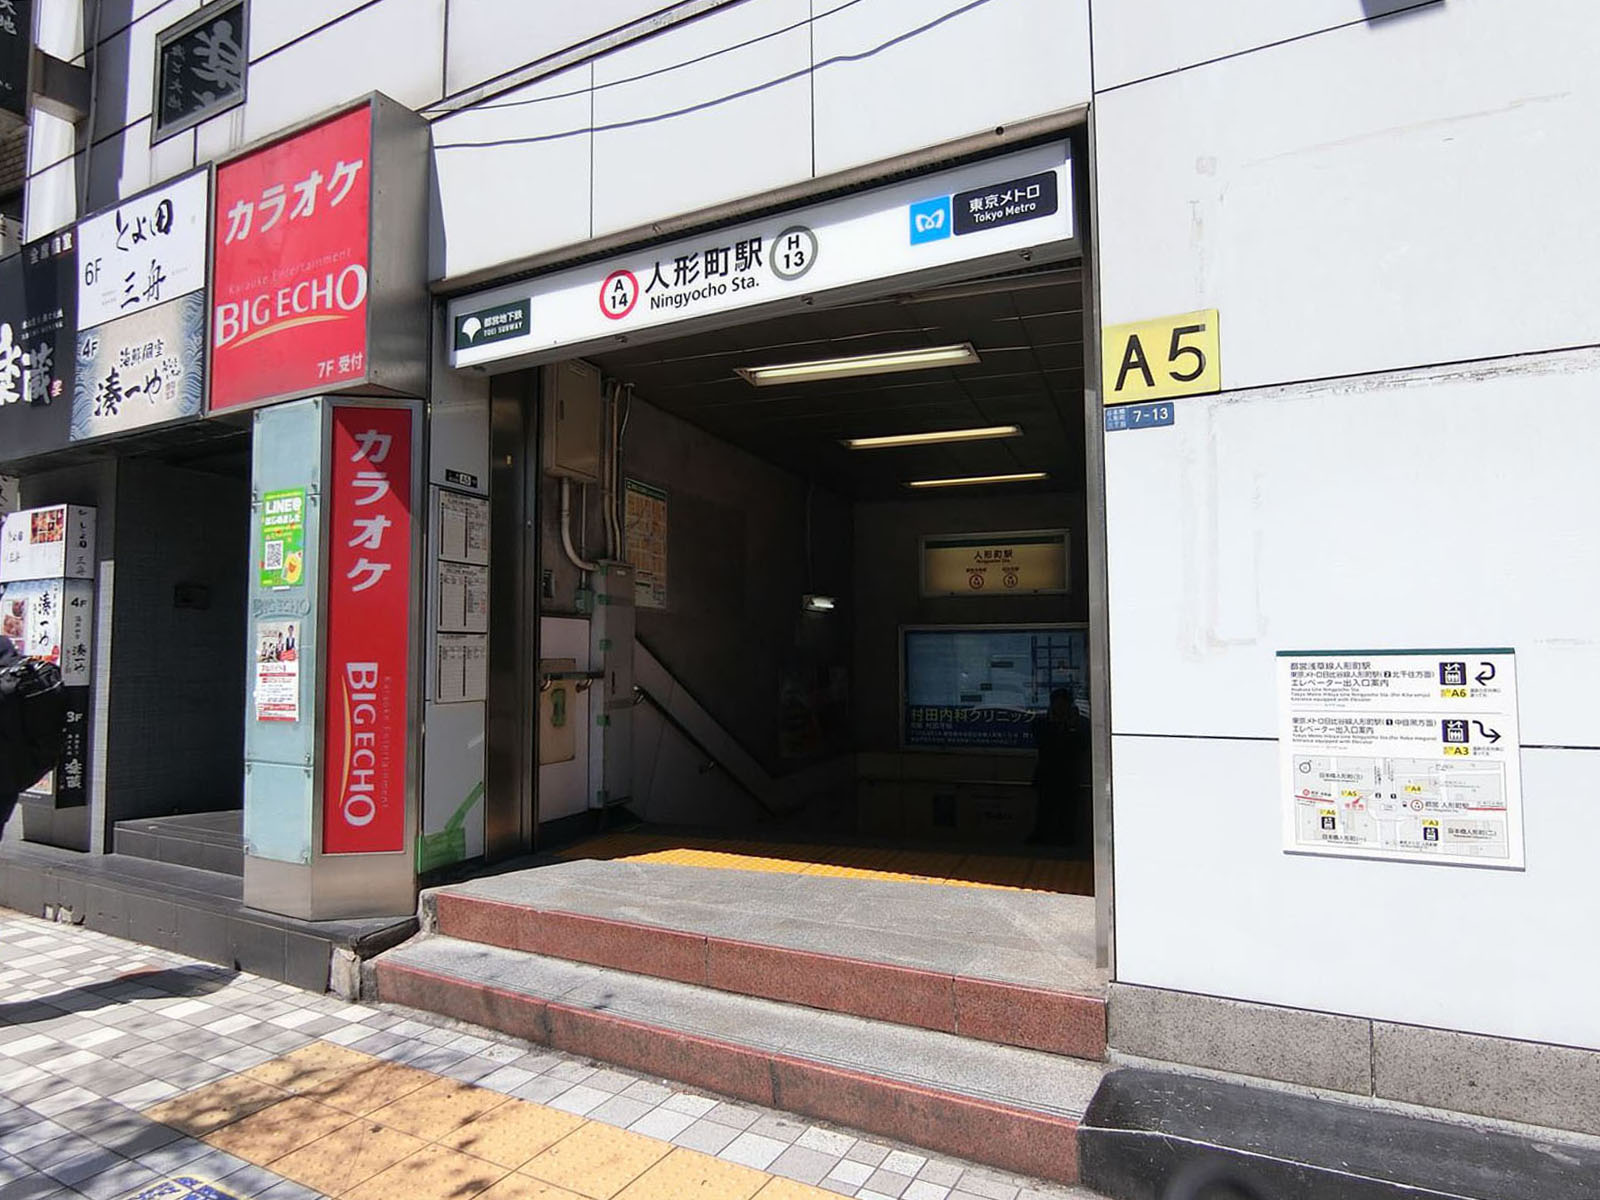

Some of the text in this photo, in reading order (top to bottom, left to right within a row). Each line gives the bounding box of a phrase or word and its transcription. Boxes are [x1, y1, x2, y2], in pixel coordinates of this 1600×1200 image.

[225, 159, 363, 246] カラオケ
[969, 184, 1041, 213] 東京メトロ
[973, 202, 1037, 224] Tokyo Metro
[787, 235, 800, 251] H
[84, 257, 102, 286] 6F
[645, 237, 763, 294] 人形町駅
[783, 252, 806, 270] 13
[614, 279, 625, 292] A
[650, 274, 761, 310] Ningyocho Sta.
[215, 263, 368, 349] BIG ECHO
[610, 292, 629, 310] 14
[82, 338, 99, 359] 4F
[1114, 323, 1207, 392] A5
[317, 352, 363, 378] 7F 受付
[94, 366, 163, 417] 湊一や
[1132, 407, 1169, 423] 7-13
[347, 429, 393, 593] カラオケ
[70, 597, 87, 608] 4F
[1291, 679, 1390, 688] エレベーター出入口案内
[1451, 688, 1467, 699] A6
[66, 711, 84, 723] 3F
[343, 662, 378, 827] BIG ECHO
[1453, 746, 1469, 757] A3
